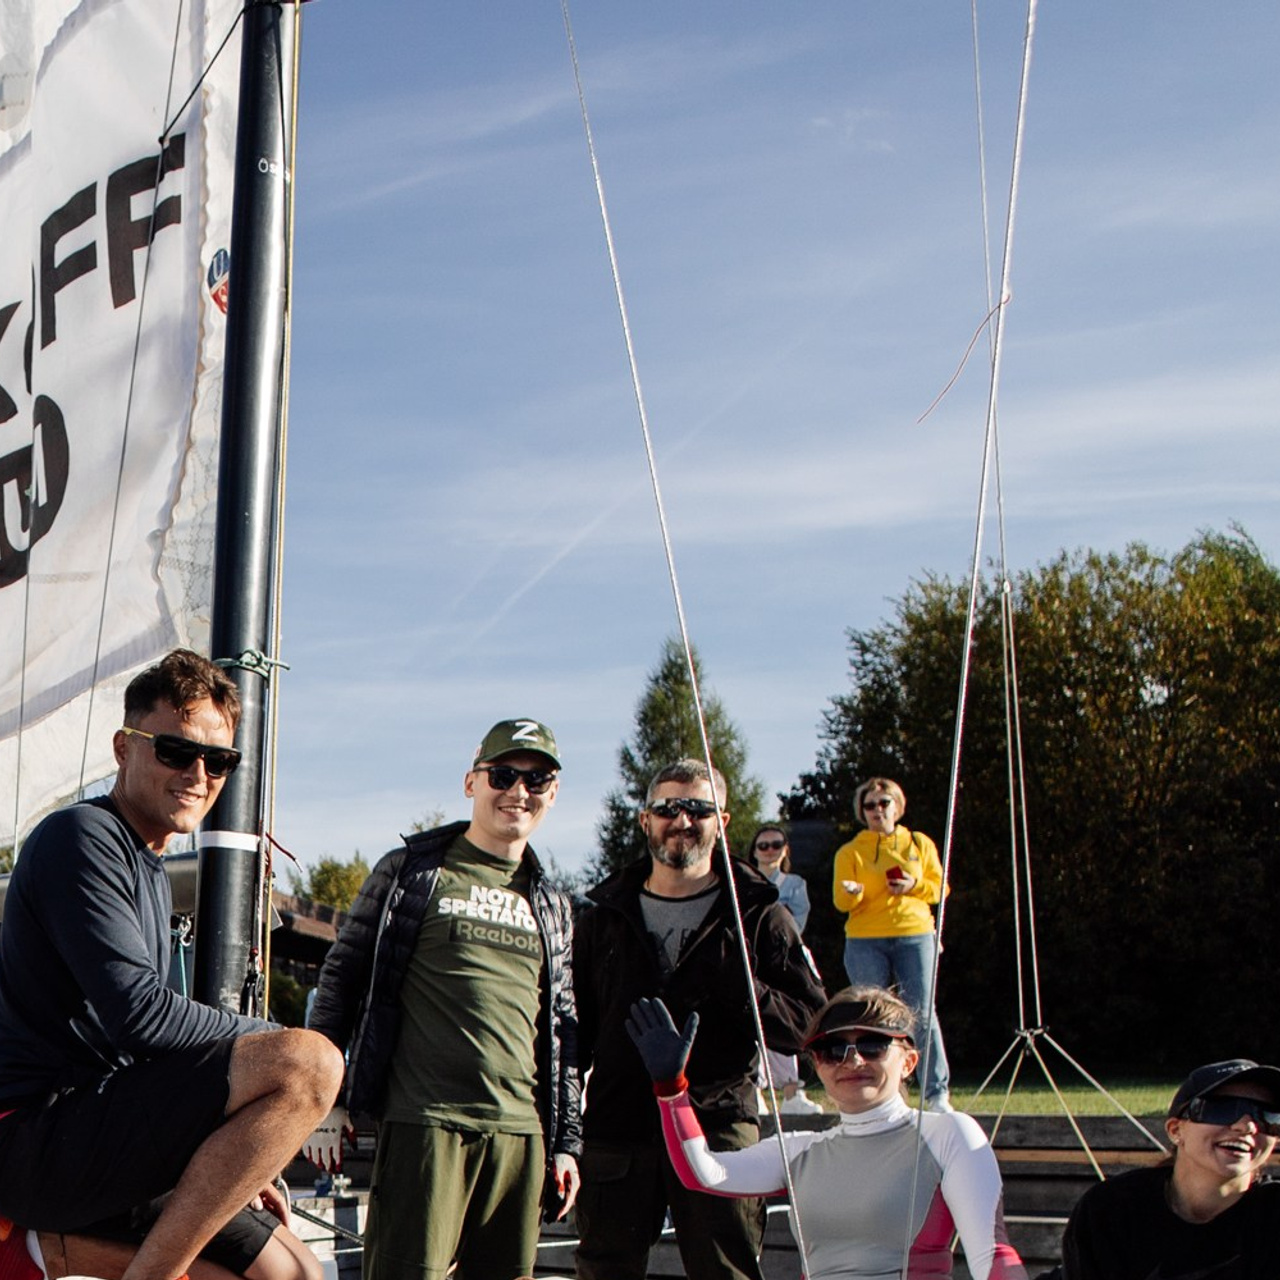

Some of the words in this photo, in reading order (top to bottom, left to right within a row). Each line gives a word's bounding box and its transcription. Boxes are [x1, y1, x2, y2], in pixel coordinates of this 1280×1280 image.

[511, 721, 539, 742] Z
[437, 897, 538, 931] SPECTATO
[470, 885, 514, 911] NOT
[516, 896, 531, 916] A
[456, 921, 540, 954] Reebok
